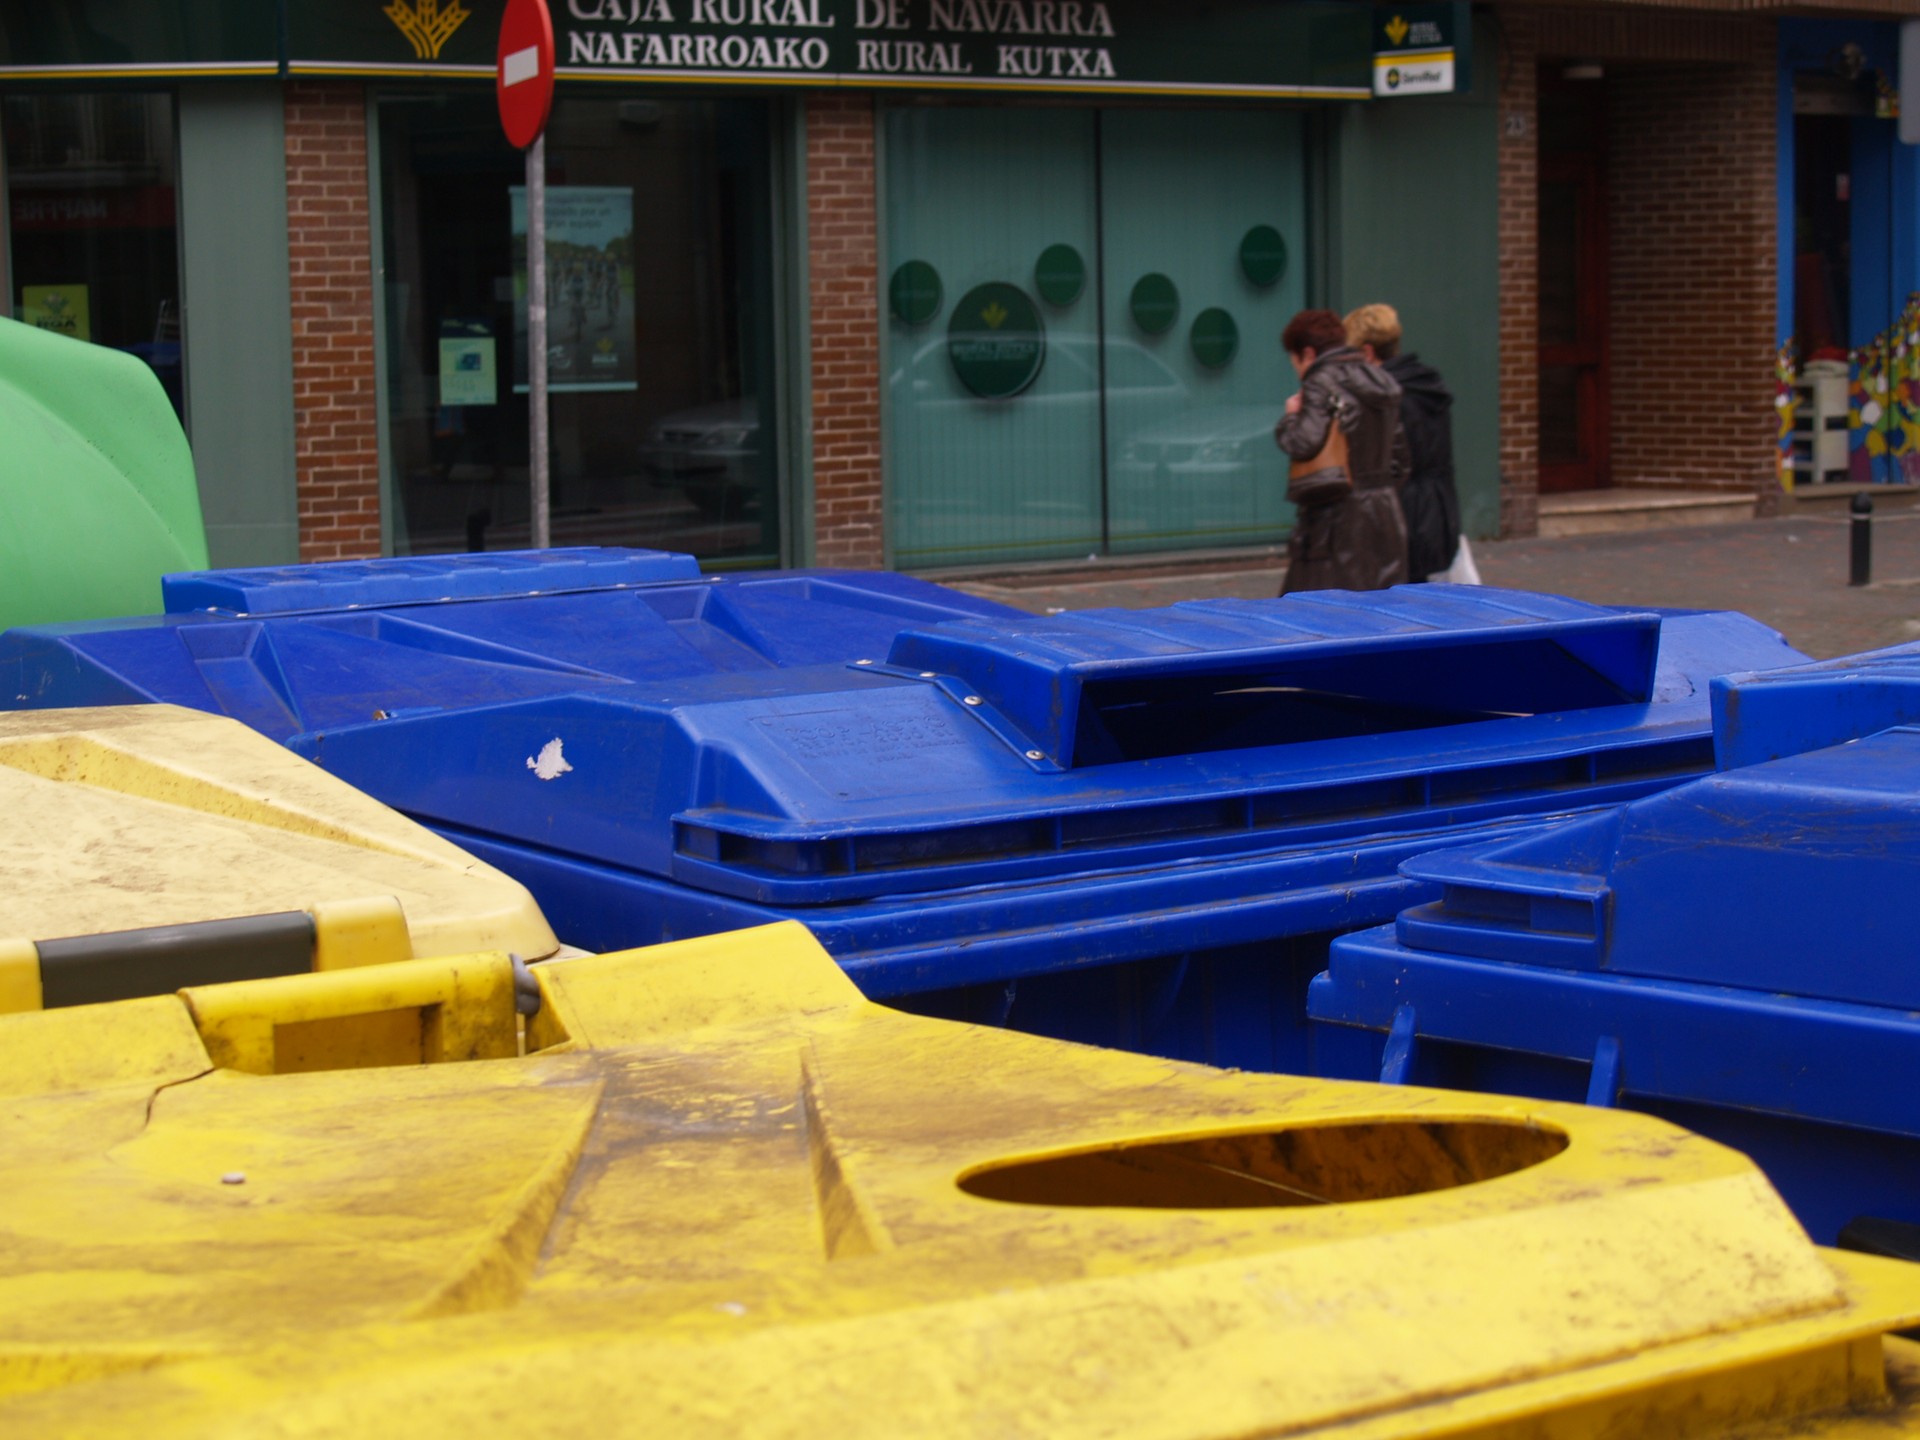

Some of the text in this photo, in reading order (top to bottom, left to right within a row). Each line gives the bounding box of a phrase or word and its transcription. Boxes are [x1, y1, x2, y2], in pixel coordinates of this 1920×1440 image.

[568, 0, 1116, 37] CAJA RURAL DE NAVARRA
[568, 30, 1117, 78] NAFARROAKO RURAL KUTXA
